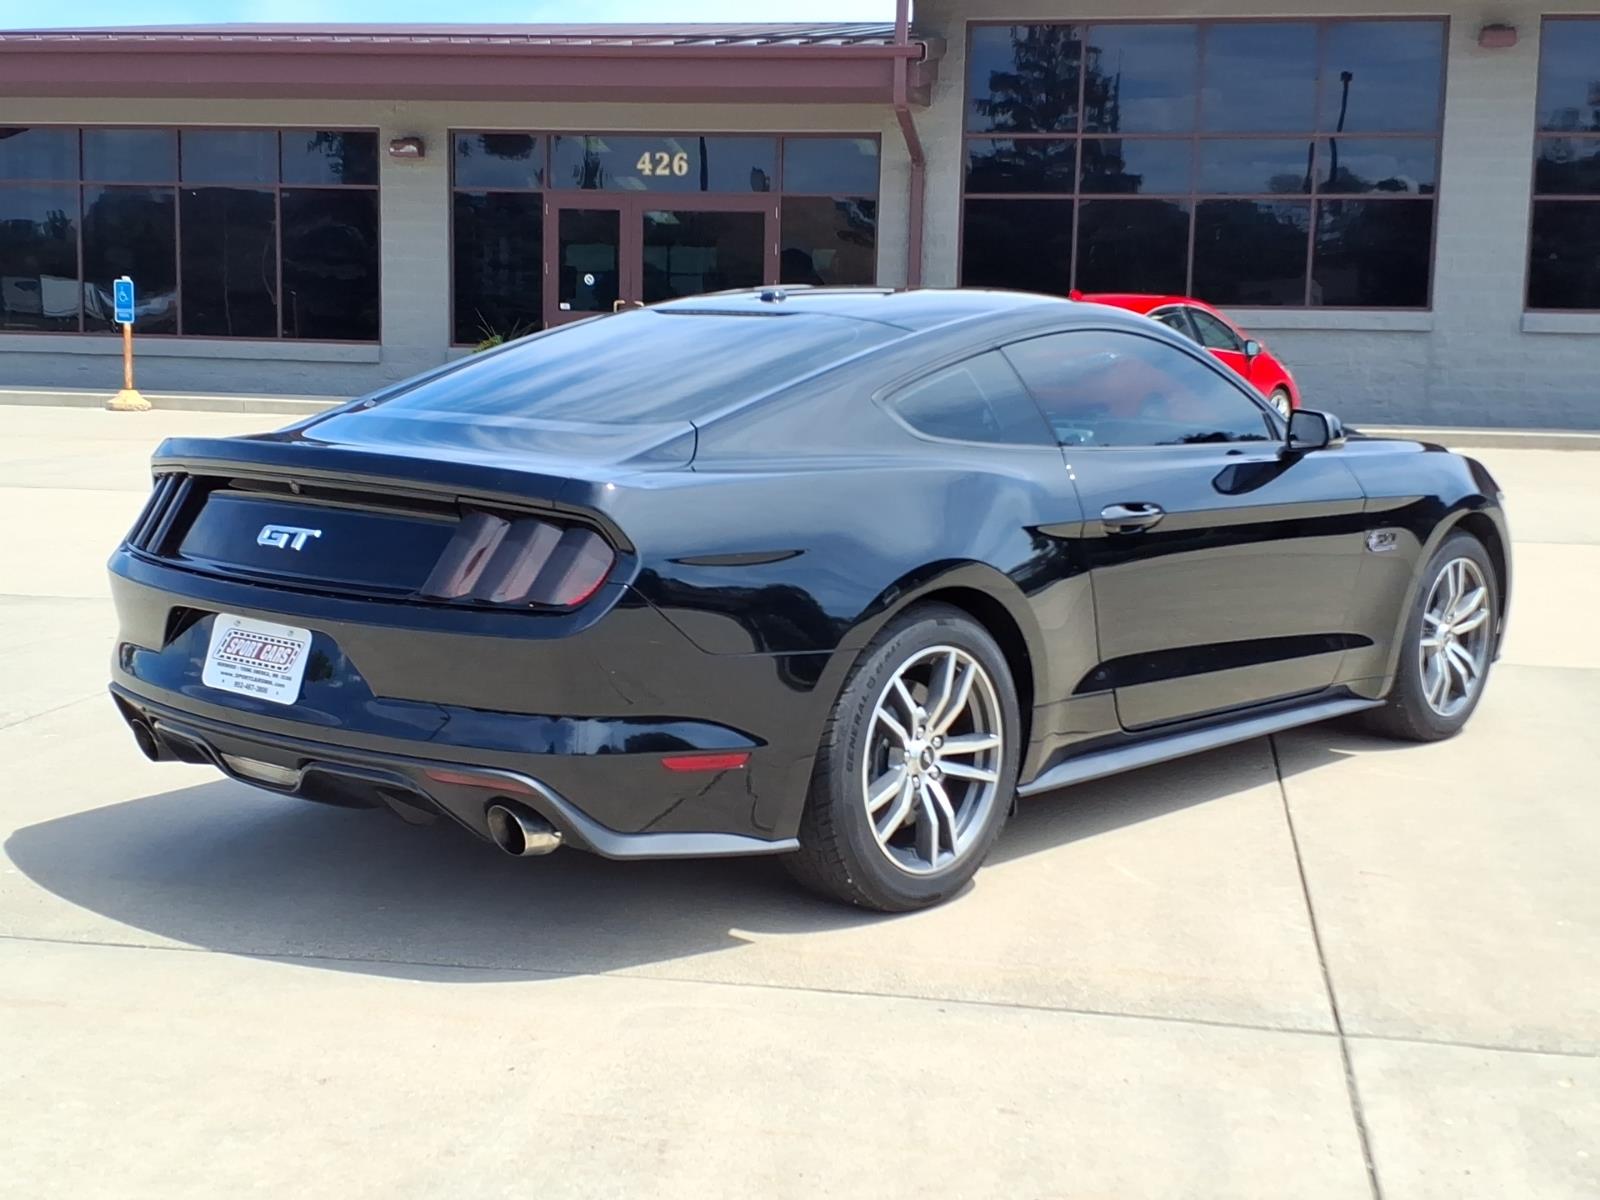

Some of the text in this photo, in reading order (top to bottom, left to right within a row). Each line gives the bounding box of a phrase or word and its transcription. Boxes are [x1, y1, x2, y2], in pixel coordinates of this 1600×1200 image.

[636, 152, 688, 176] 426
[257, 525, 321, 551] GT
[226, 638, 292, 664] SPORT CARS
